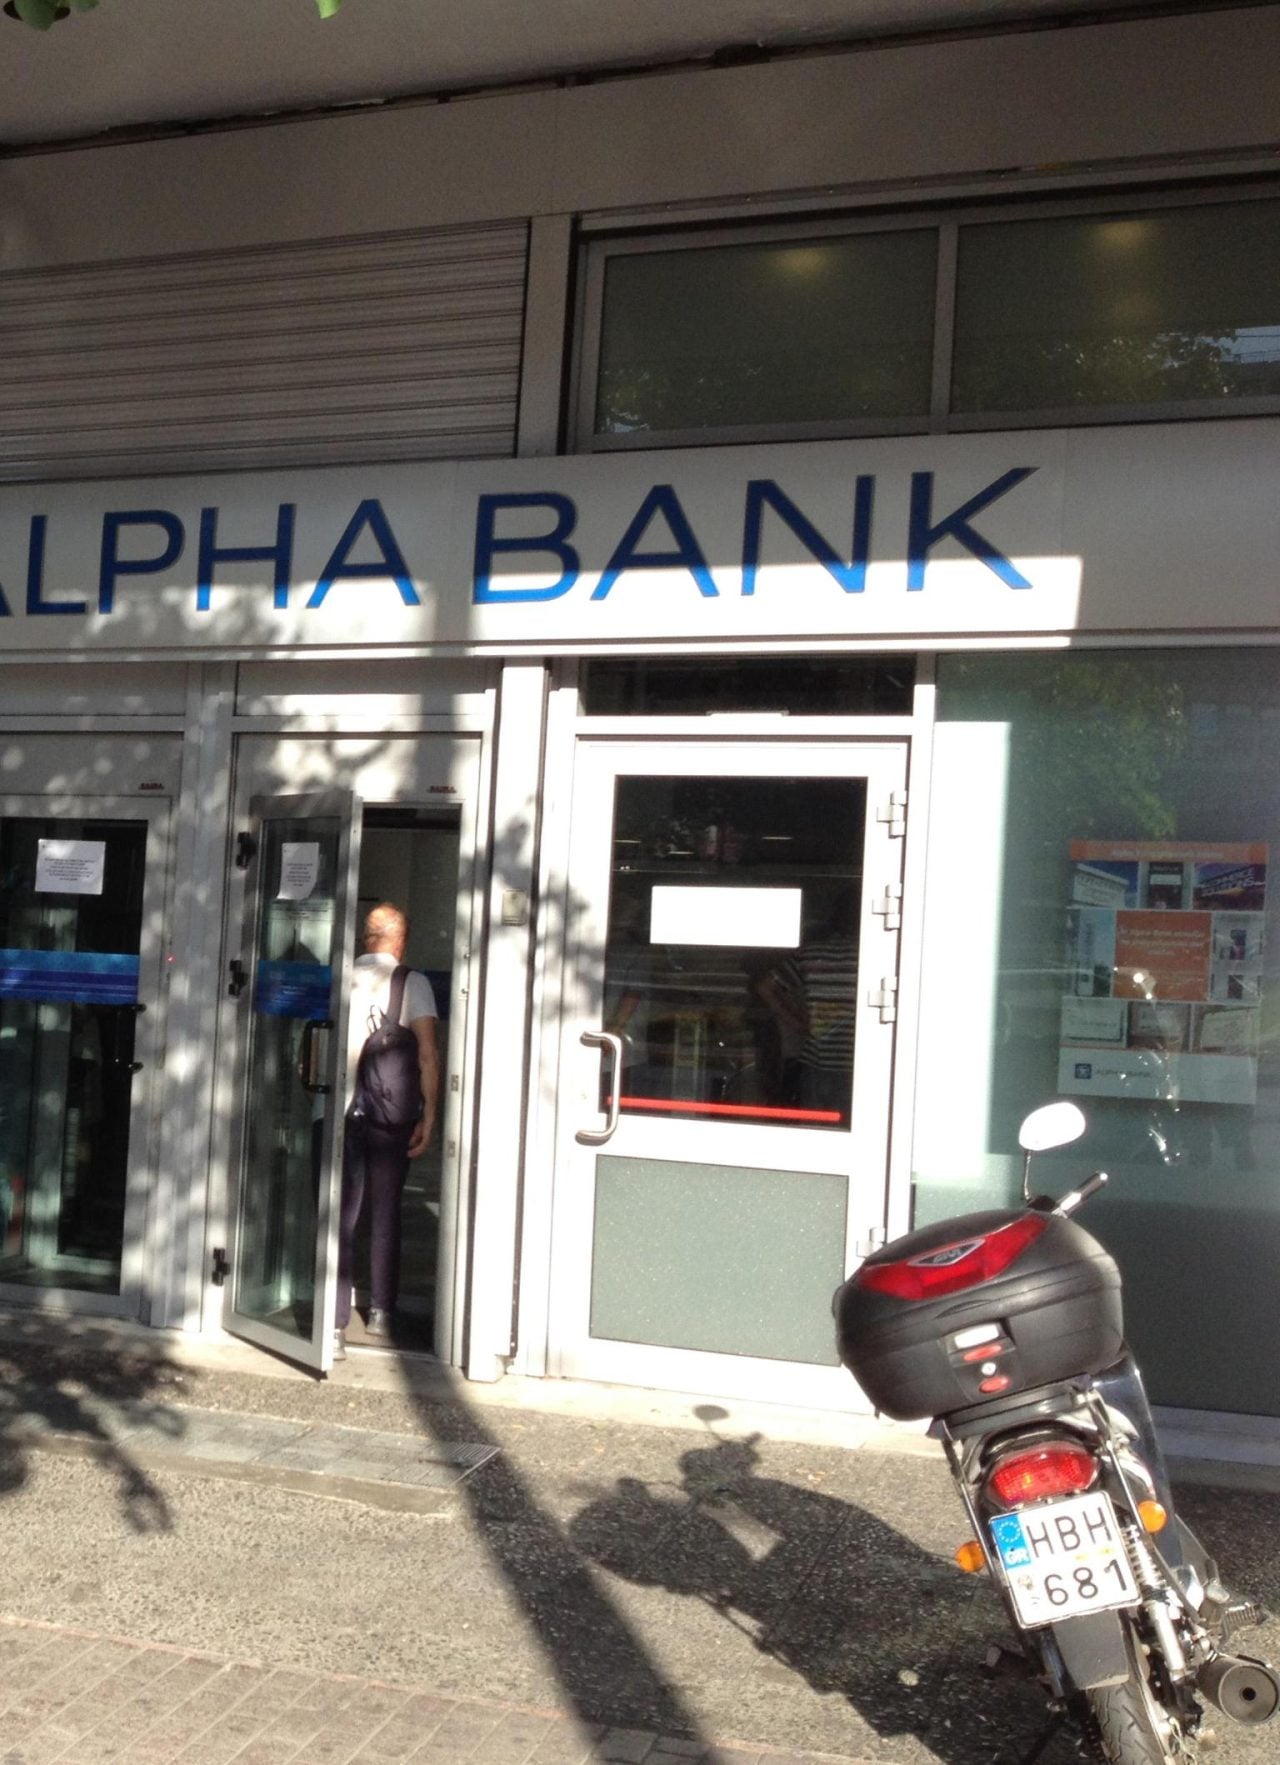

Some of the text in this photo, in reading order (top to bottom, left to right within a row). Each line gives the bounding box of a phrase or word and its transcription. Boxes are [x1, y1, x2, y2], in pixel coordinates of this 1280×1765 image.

[472, 466, 1041, 606] BANK
[1026, 1507, 1113, 1558] HBH
[1044, 1559, 1128, 1606] 681
